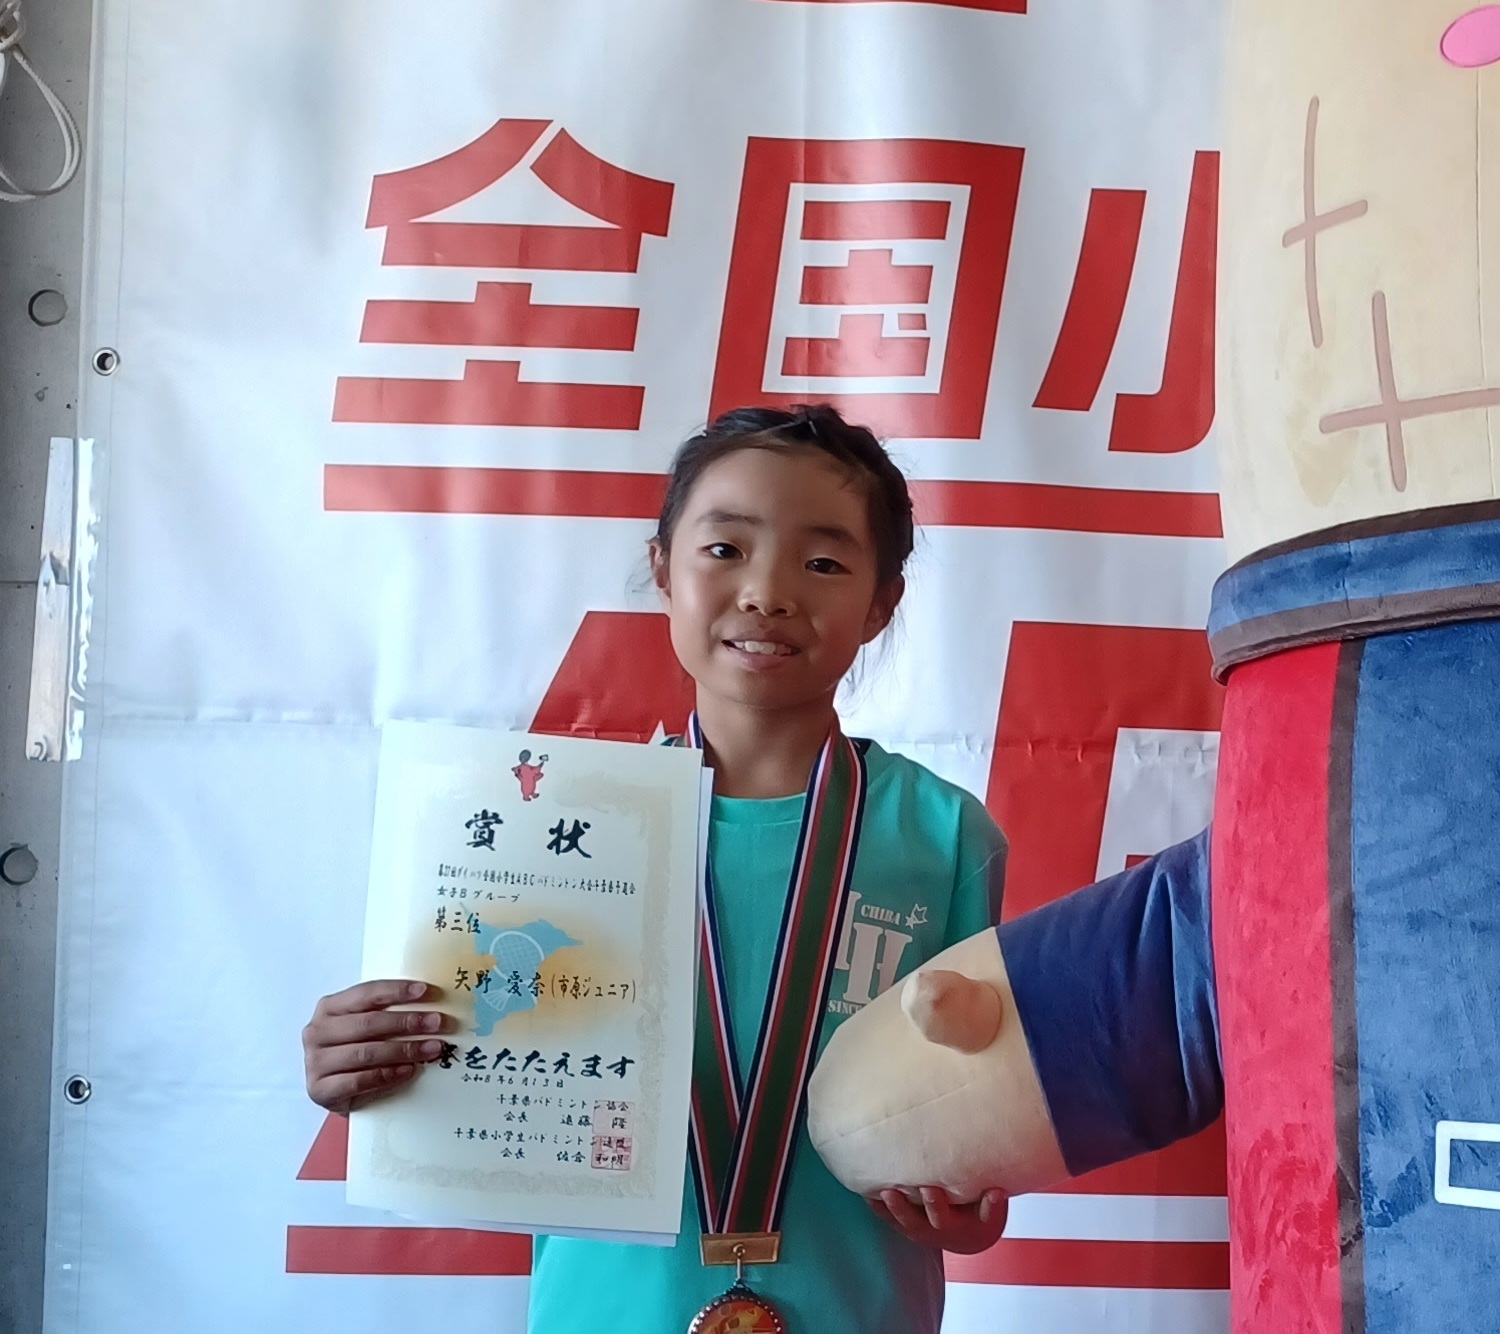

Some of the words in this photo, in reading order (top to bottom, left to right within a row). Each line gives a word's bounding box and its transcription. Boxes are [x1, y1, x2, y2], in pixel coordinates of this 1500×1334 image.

[434, 904, 482, 934] 第三位
[860, 903, 901, 926] CHIBA
